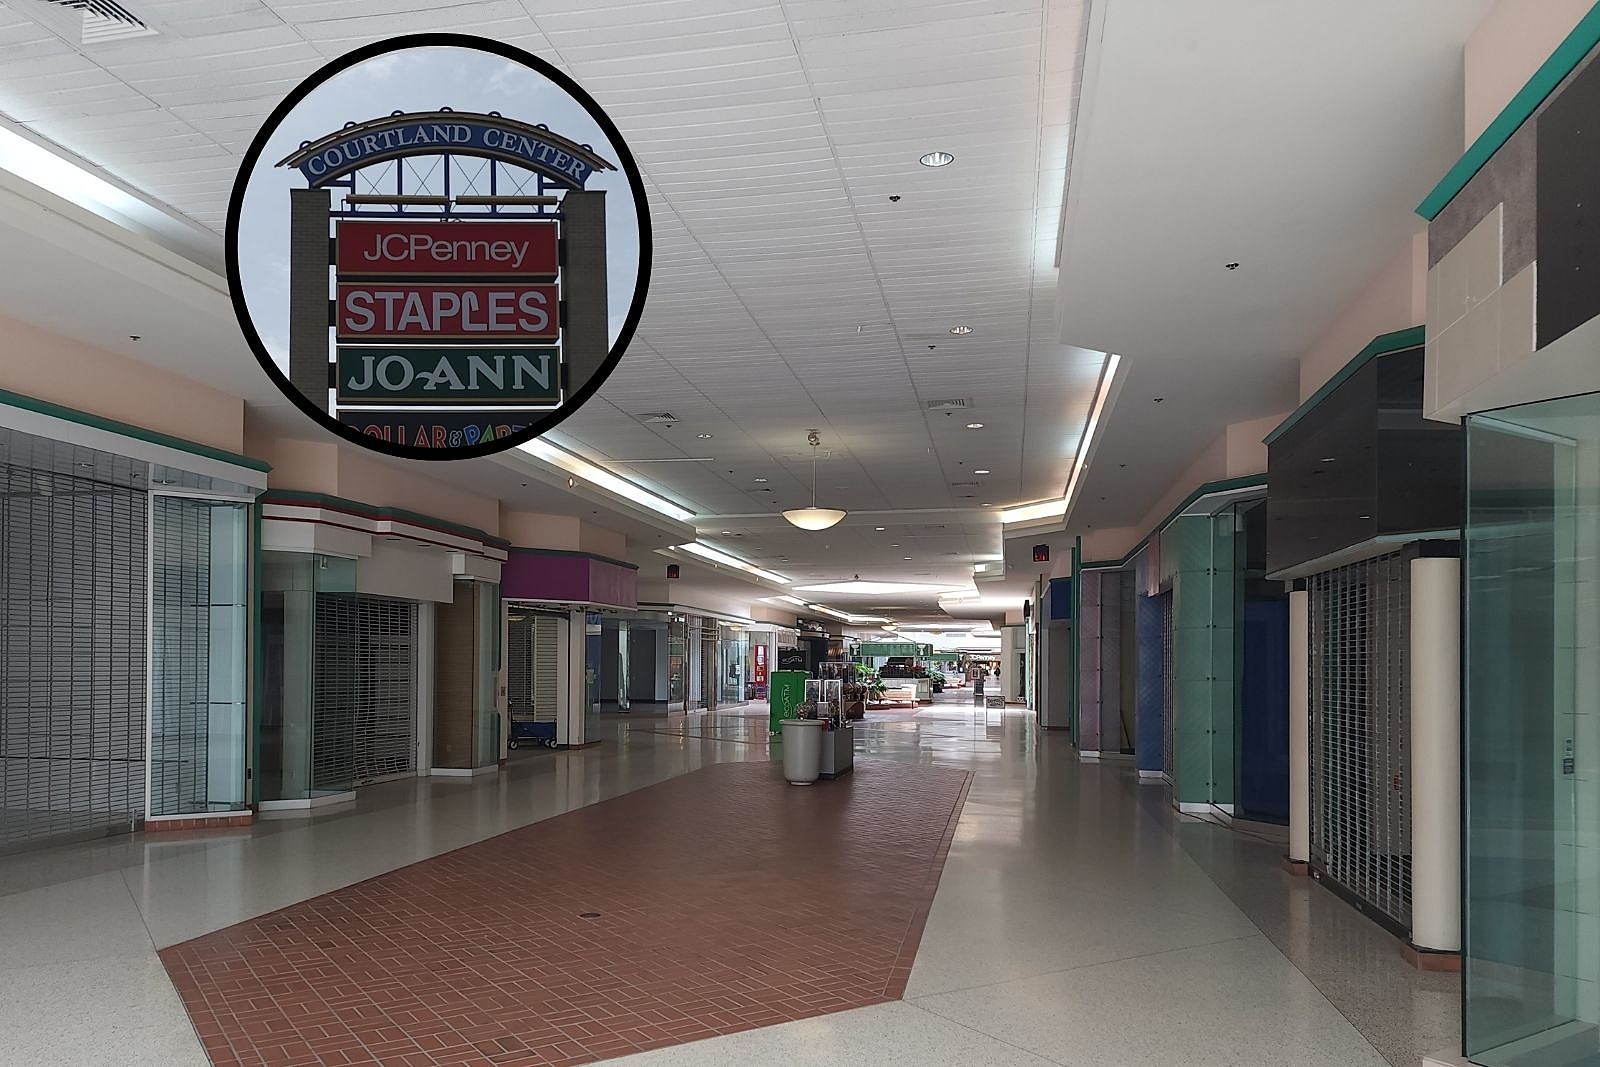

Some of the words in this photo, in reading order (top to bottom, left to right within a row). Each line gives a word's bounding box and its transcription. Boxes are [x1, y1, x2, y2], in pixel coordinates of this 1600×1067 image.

[308, 125, 472, 175] COURTLAND
[483, 128, 586, 180] CENTER
[363, 233, 529, 268] JCPenney
[345, 290, 548, 332] STAPLES
[783, 684, 791, 718] ecoATM
